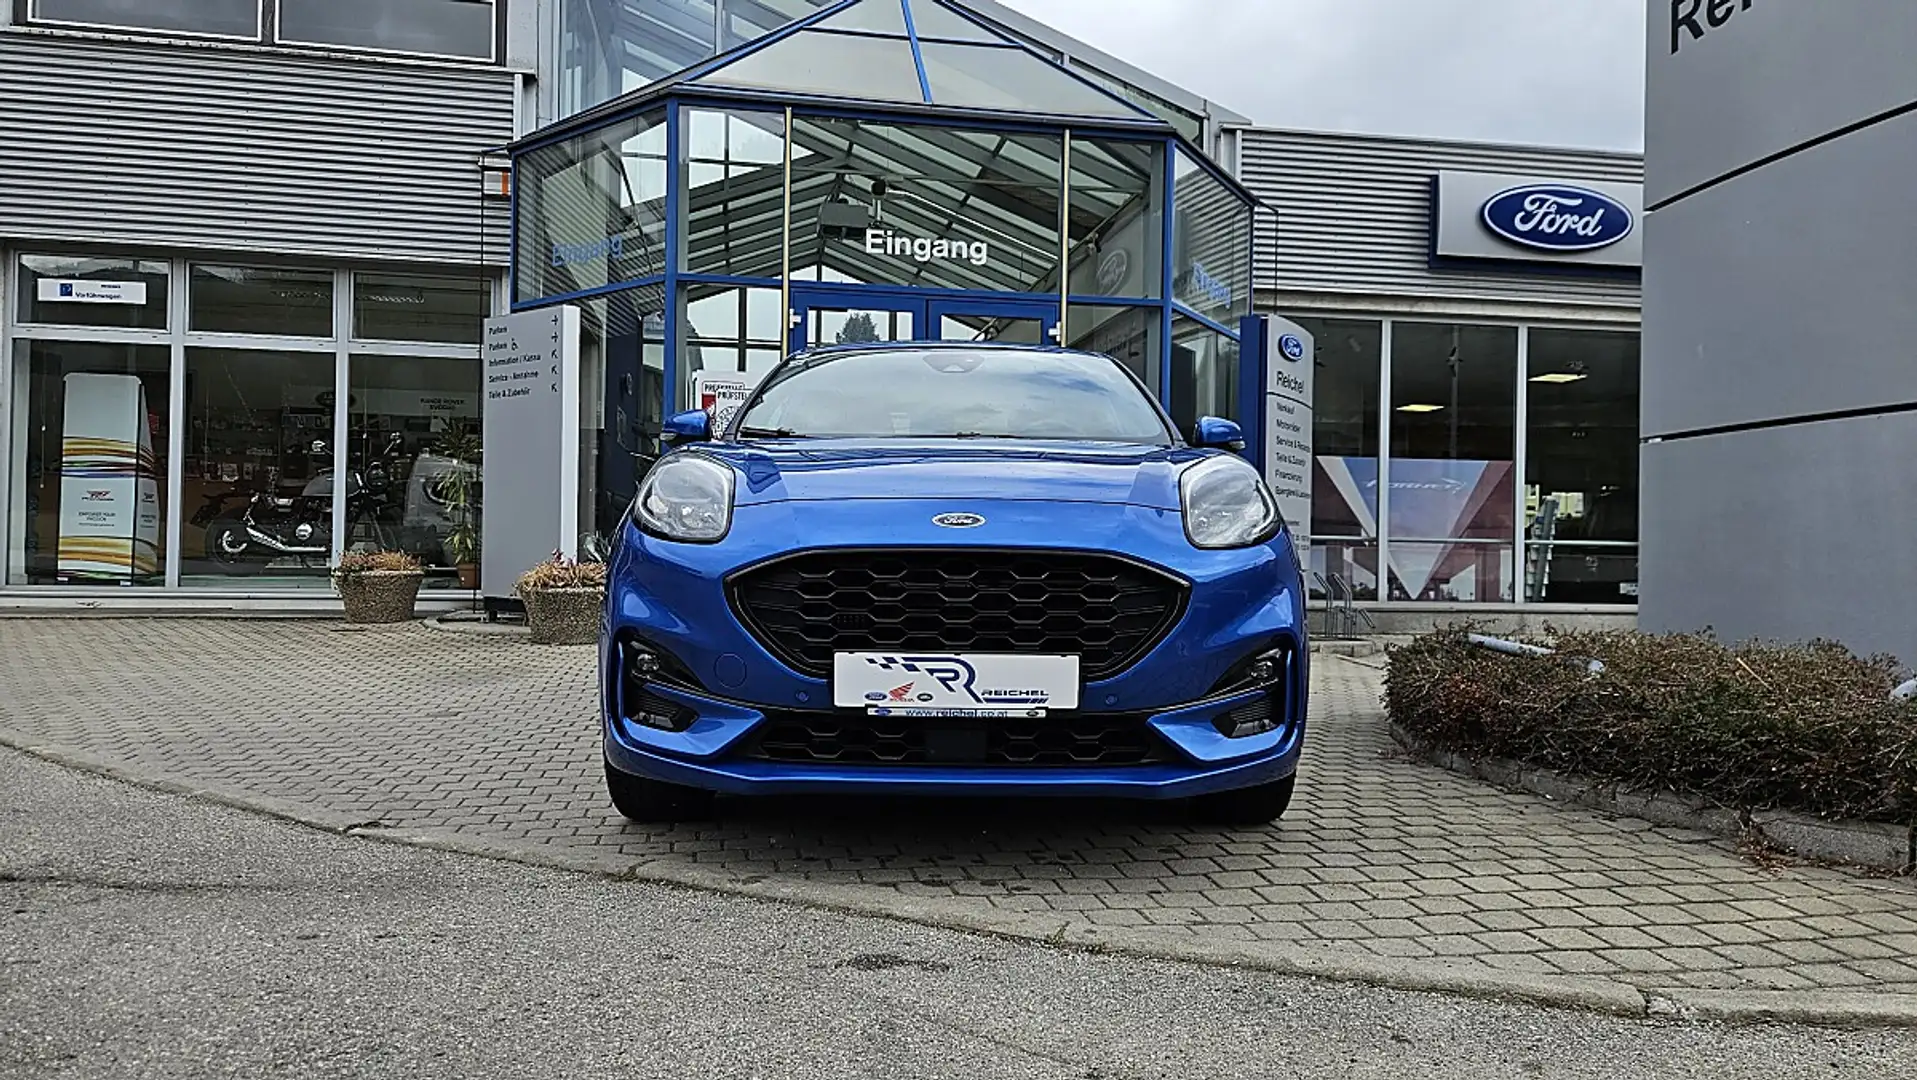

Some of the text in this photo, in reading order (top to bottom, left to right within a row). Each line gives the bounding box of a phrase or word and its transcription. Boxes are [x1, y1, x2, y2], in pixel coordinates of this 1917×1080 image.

[1671, 0, 1753, 54] Re
[1514, 193, 1605, 236] Ford
[865, 227, 988, 265] Eingang
[1276, 370, 1305, 394] Reichel
[981, 689, 1050, 697] REICHEL
[904, 709, 1008, 718] www.reichel.co.at
